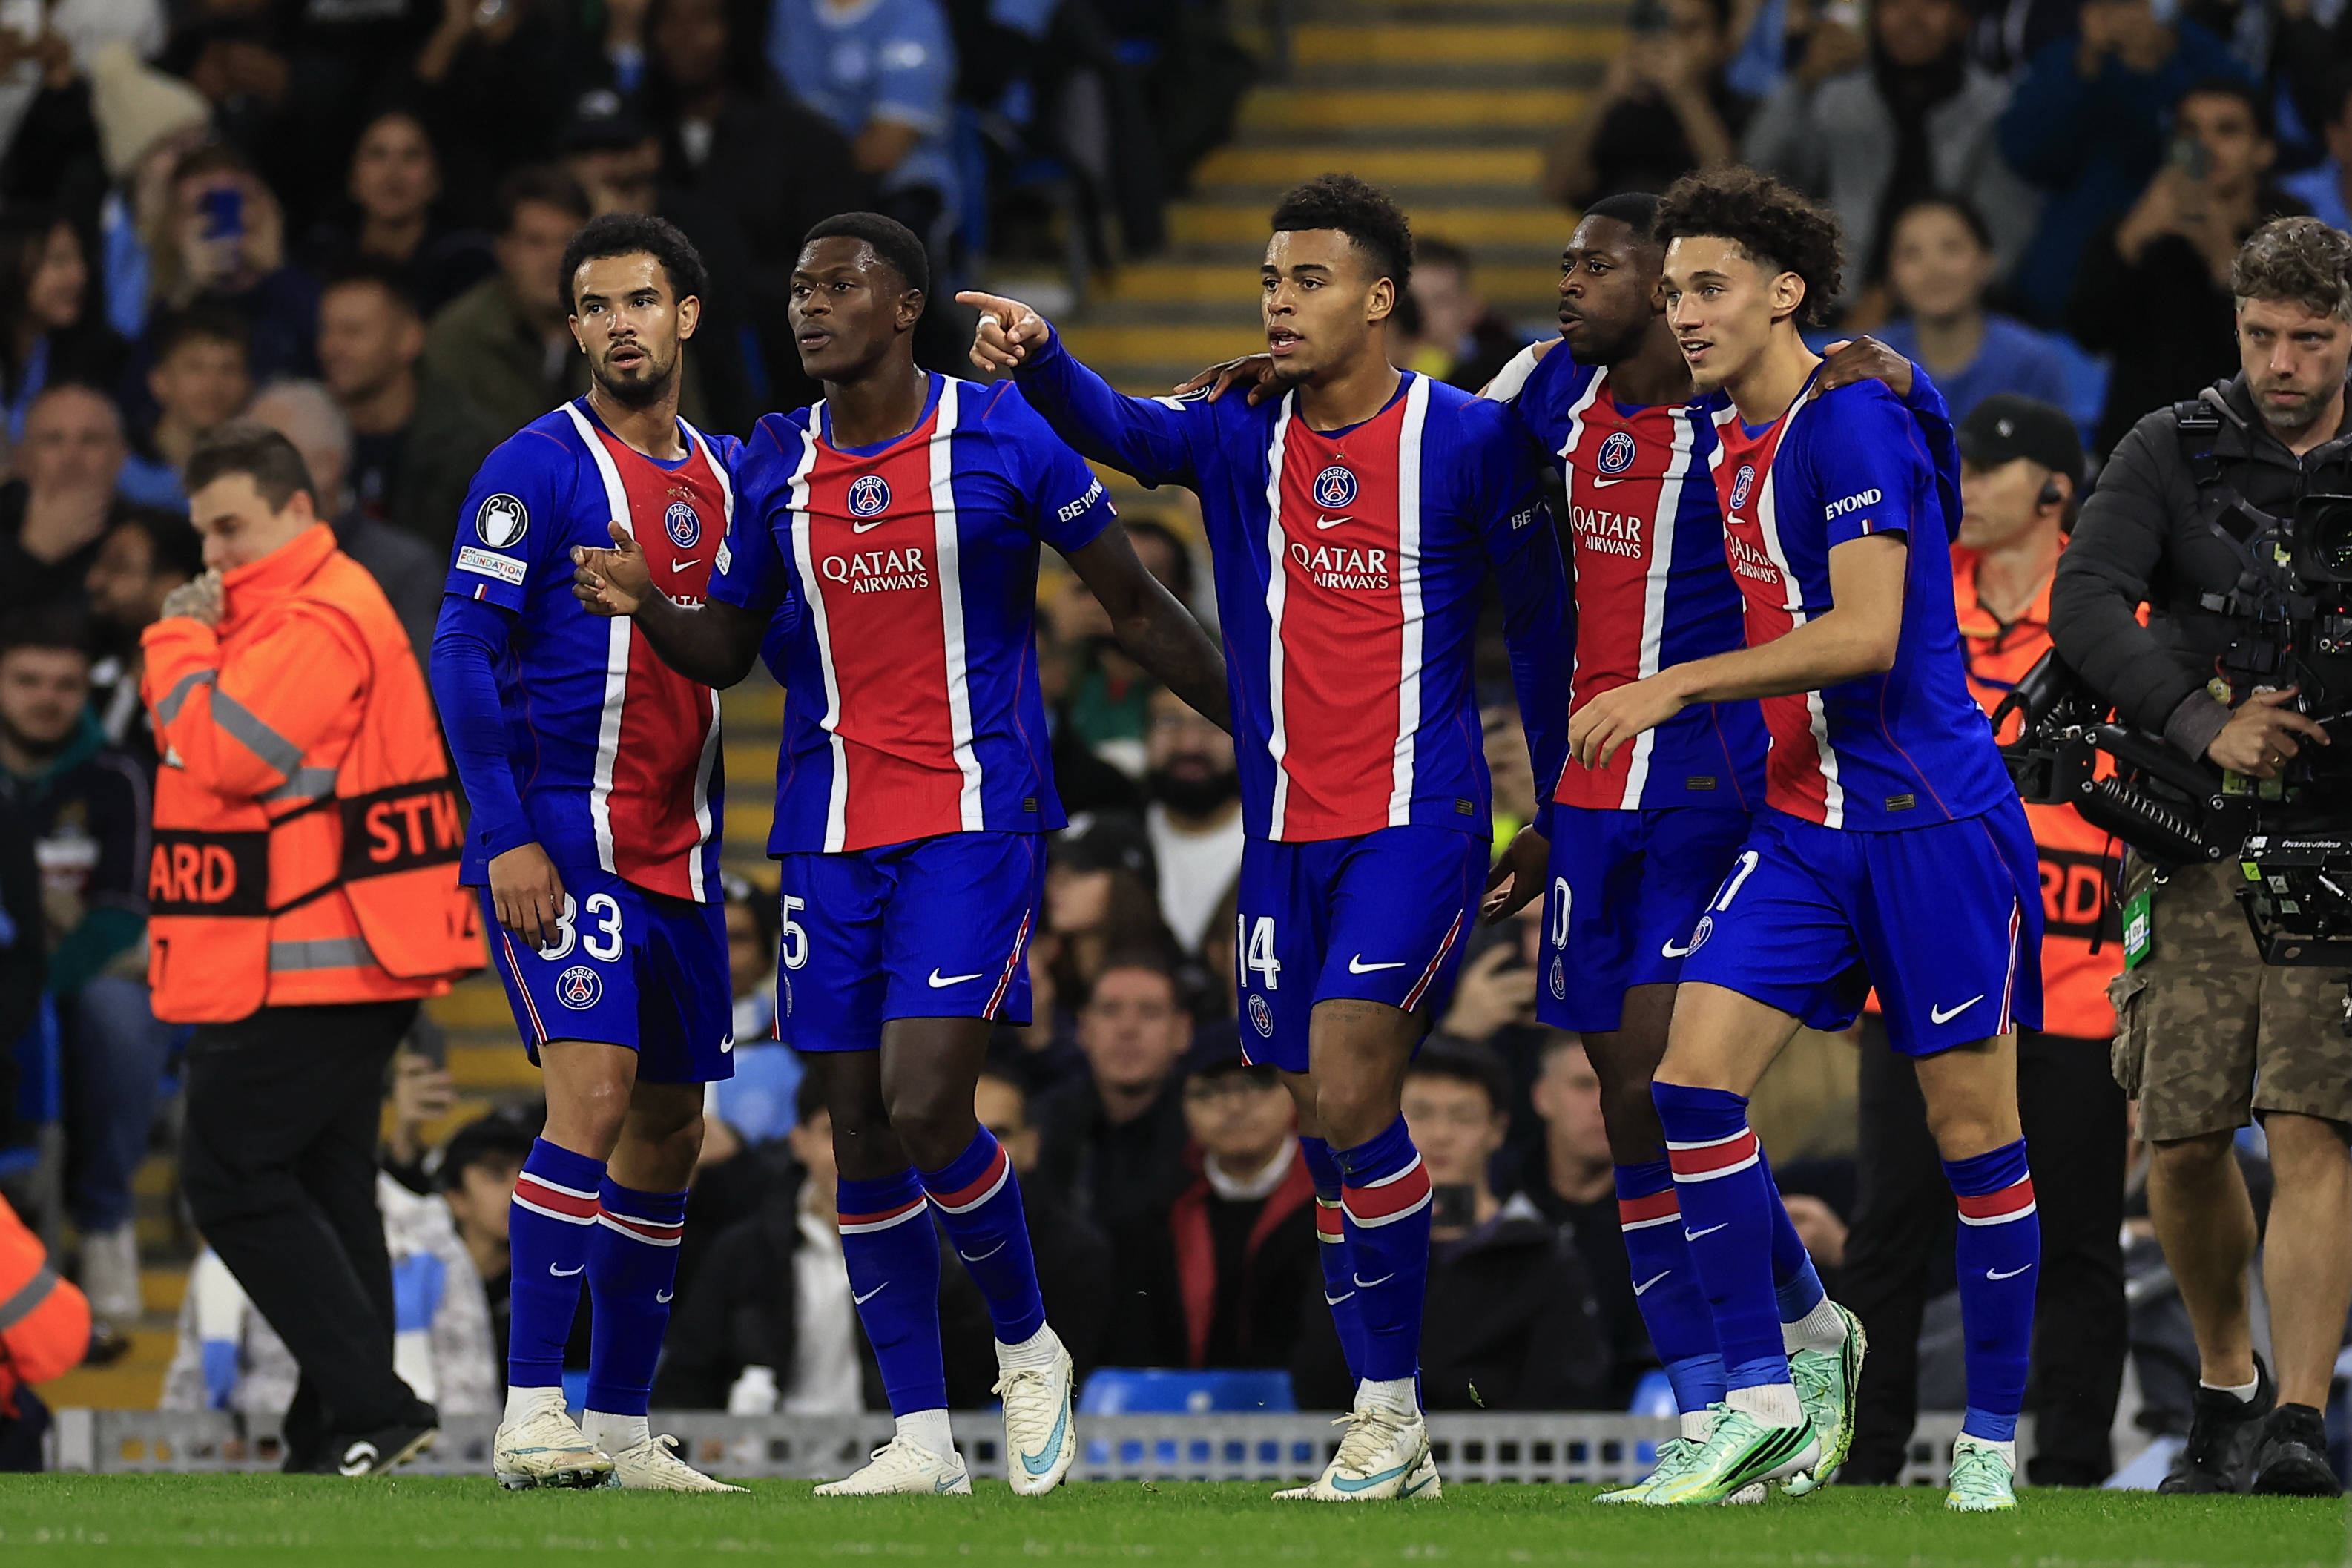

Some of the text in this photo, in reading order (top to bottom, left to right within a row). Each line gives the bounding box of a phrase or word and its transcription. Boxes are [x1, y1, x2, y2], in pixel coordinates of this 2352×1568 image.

[1610, 435, 1633, 447] PARIS
[854, 478, 882, 490] PARIS
[1321, 469, 1349, 481] PARIS
[669, 506, 692, 518] PARIS
[1573, 506, 1641, 542] QATAR
[1291, 544, 1388, 573] QATAR
[1585, 535, 1641, 559] AIRWAYS
[461, 553, 524, 577] FOUNDATION
[822, 548, 926, 584] QATAR
[1734, 559, 1778, 584] AIRWAYS
[853, 573, 929, 593] AIRWAYS
[1314, 572, 1389, 590] AIRWAYS
[148, 843, 237, 903] ARD
[783, 895, 808, 970] 5
[1238, 913, 1281, 989] 14
[564, 968, 594, 979] PARIS
